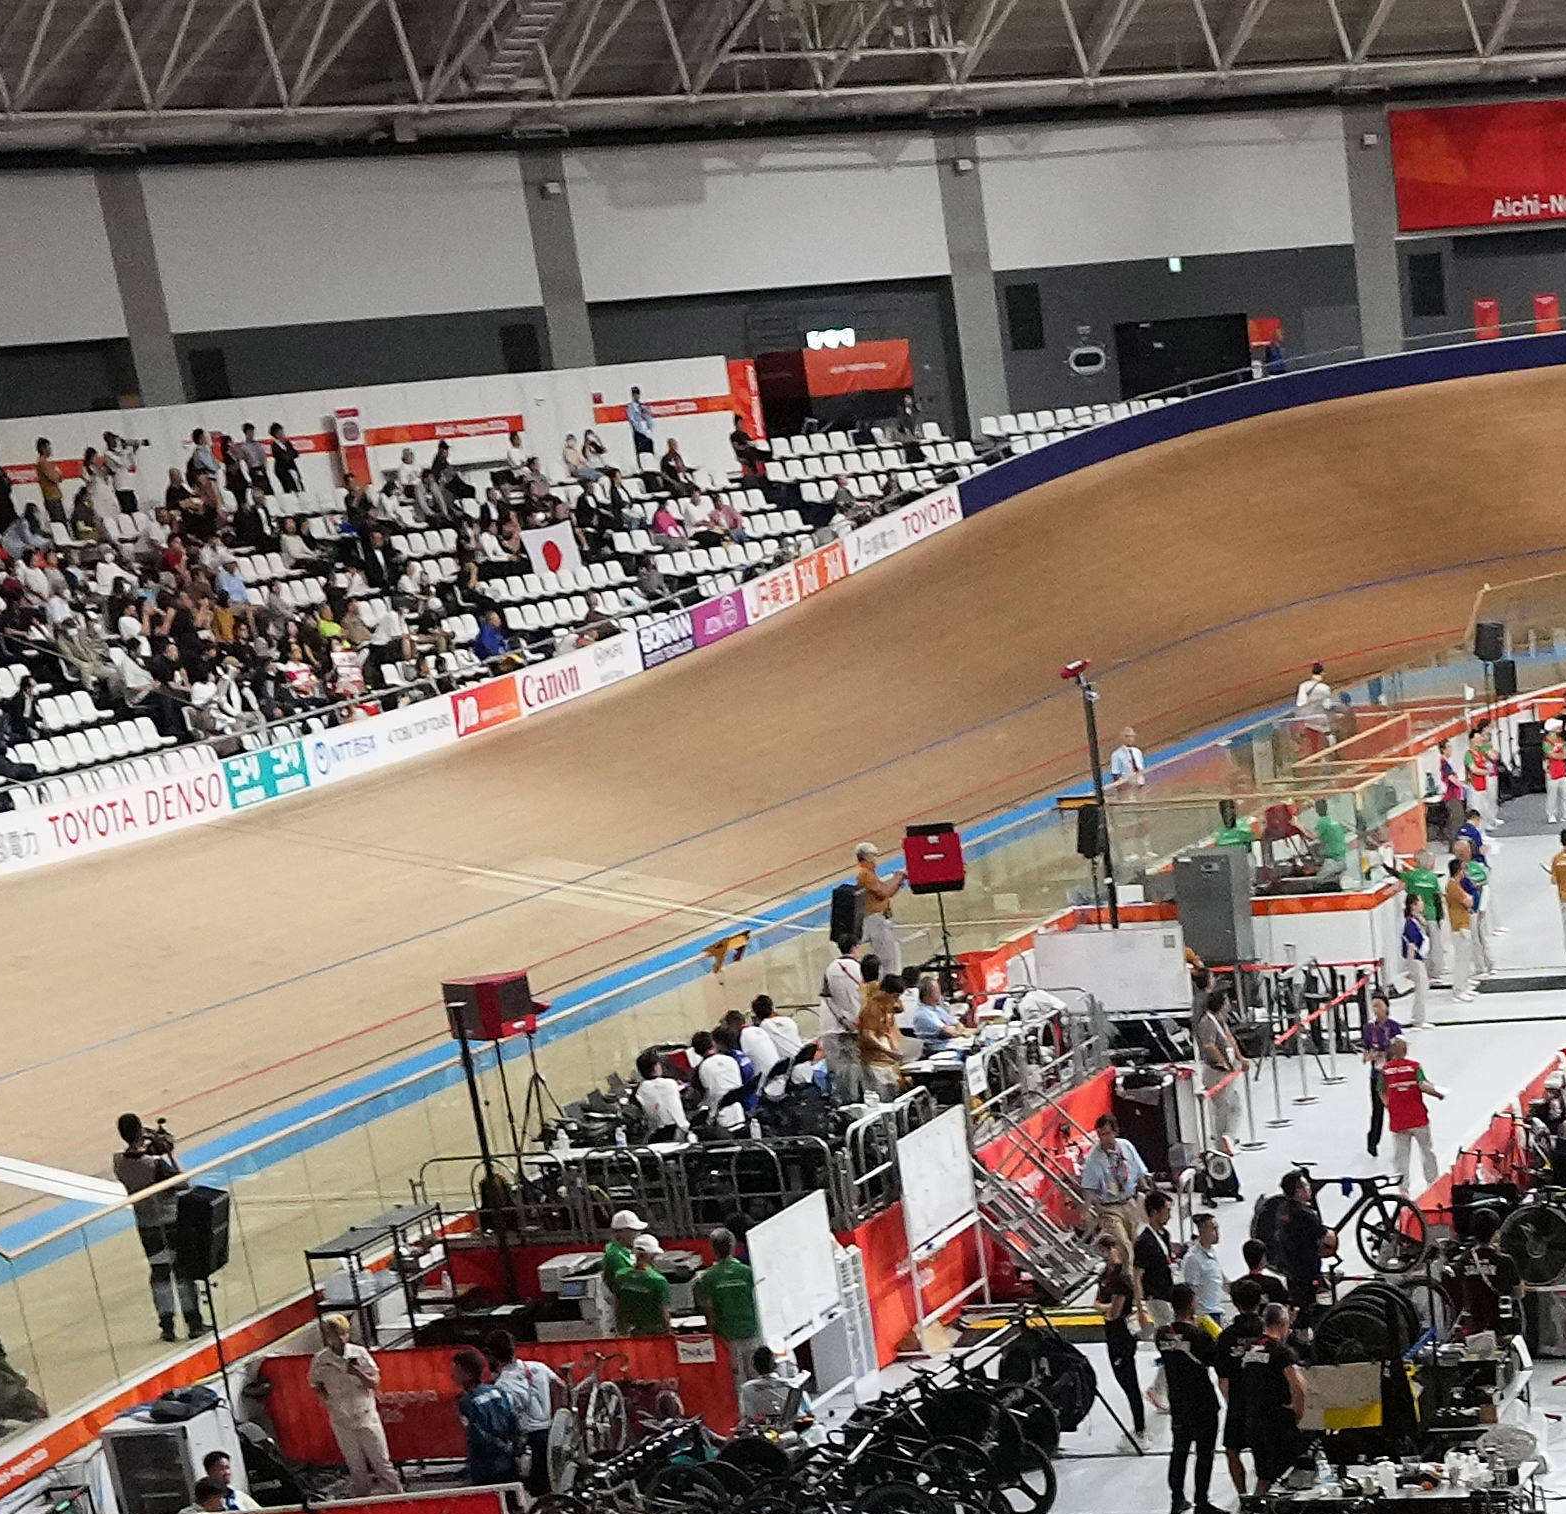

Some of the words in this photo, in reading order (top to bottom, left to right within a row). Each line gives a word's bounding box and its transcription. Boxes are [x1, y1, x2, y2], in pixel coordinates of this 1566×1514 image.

[902, 496, 957, 538] TOYOTA
[522, 666, 580, 707] Canon
[48, 799, 138, 847] TOYOTA
[145, 773, 223, 825] DENSO
